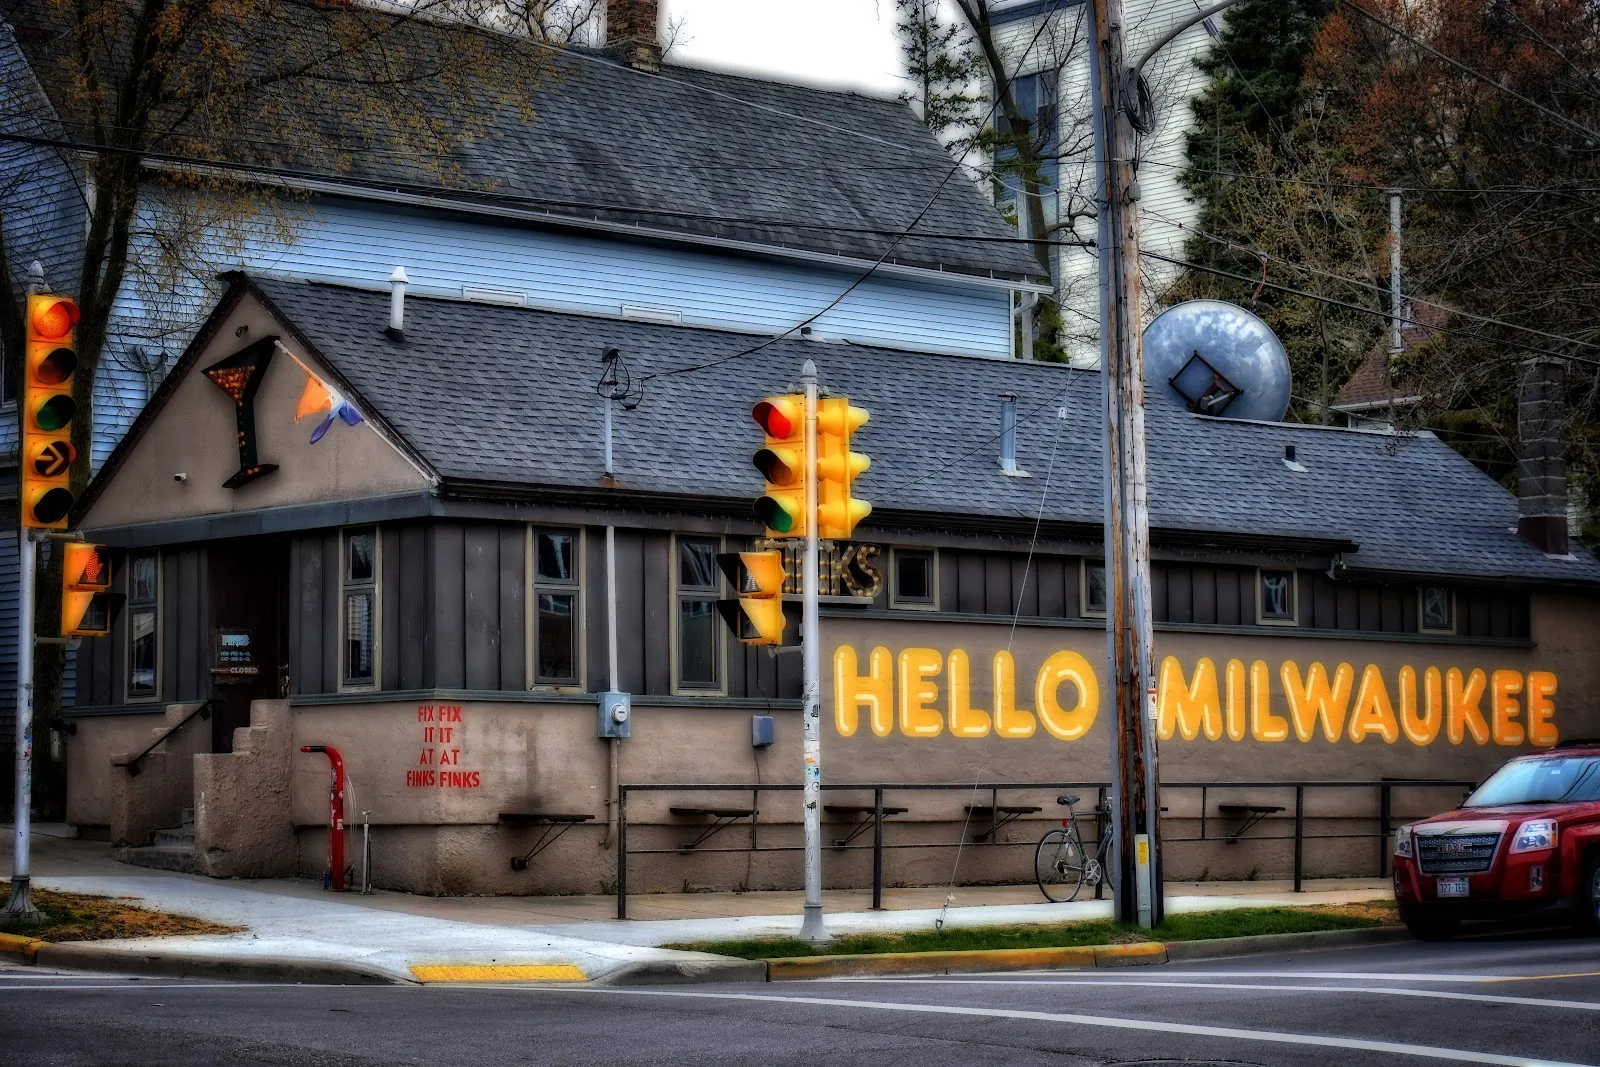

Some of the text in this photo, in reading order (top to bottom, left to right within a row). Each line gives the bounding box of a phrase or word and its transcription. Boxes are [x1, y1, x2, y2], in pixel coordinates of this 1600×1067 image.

[755, 538, 883, 597] INKS
[834, 644, 1559, 747] HELLO MILWAUKEE
[418, 706, 435, 722] FIX
[438, 706, 463, 722] FIX
[424, 727, 435, 743] IT
[439, 727, 453, 743] IT
[419, 748, 435, 765] AT
[439, 748, 460, 765] AT
[406, 770, 436, 787] FINKS
[439, 771, 481, 788] FINKS
[1437, 842, 1473, 854] GMC
